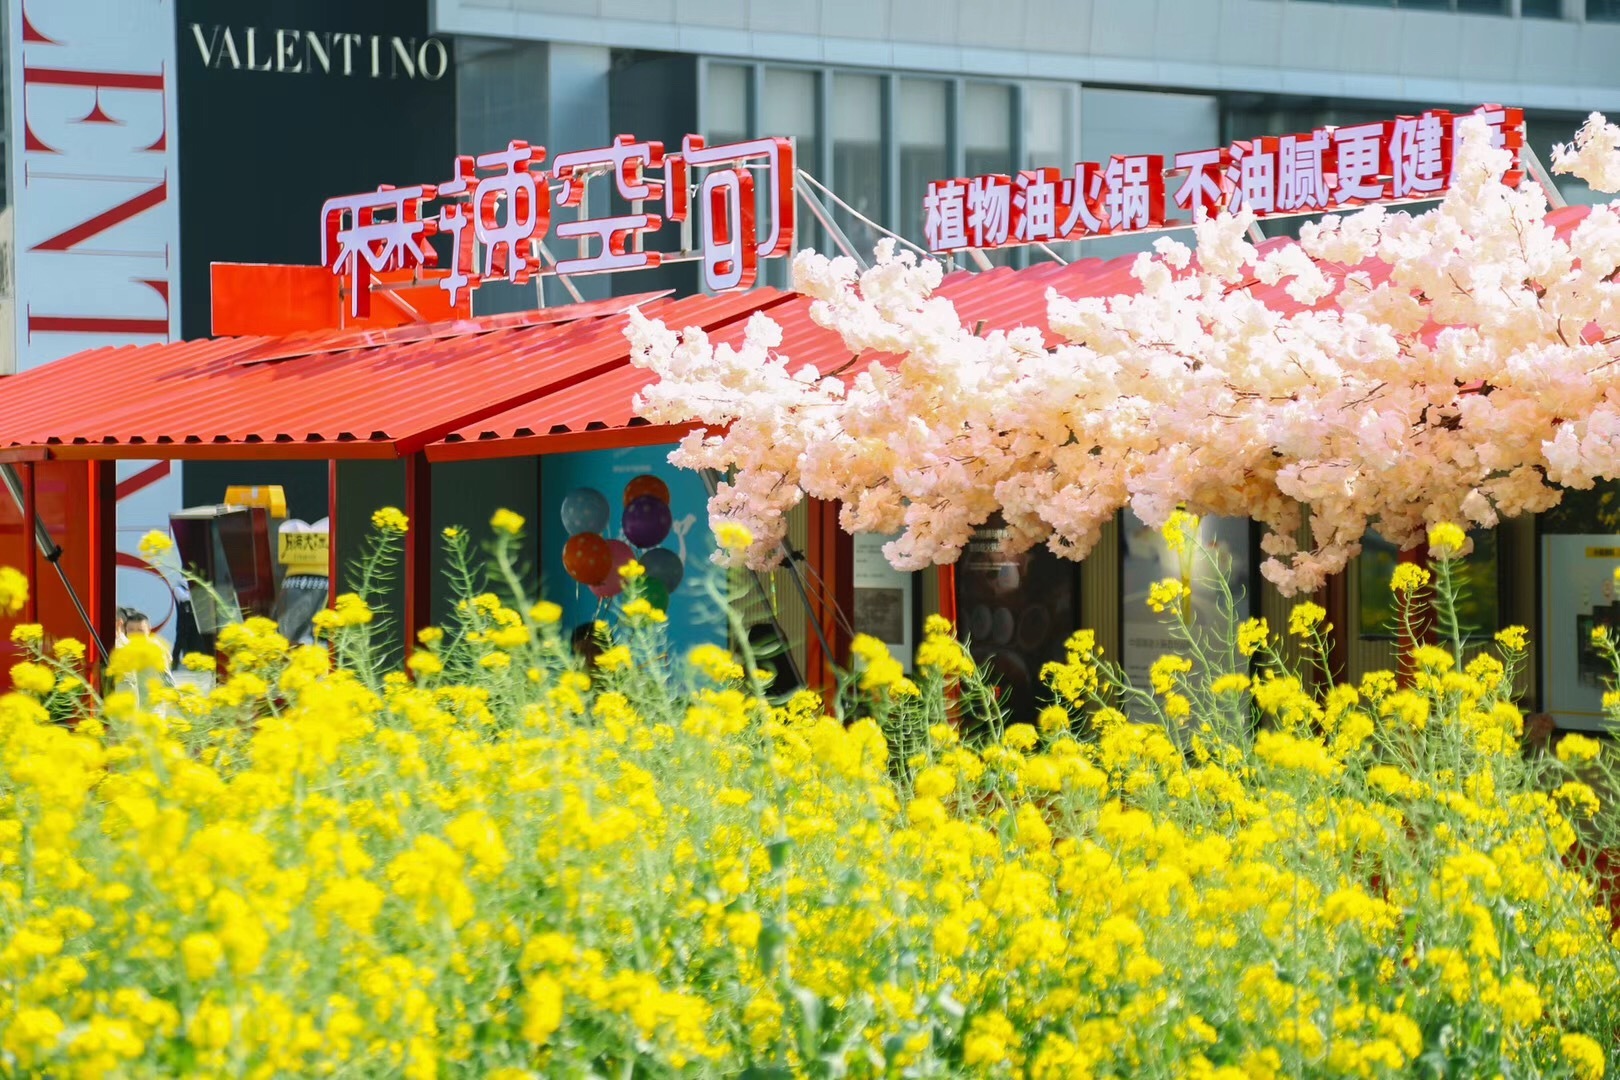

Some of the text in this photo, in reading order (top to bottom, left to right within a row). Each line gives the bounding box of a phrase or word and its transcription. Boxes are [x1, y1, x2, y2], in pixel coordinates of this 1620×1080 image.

[191, 23, 448, 80] VALENTINO
[320, 135, 786, 318] 麻辣空间
[924, 154, 1155, 251] 植物油火锅
